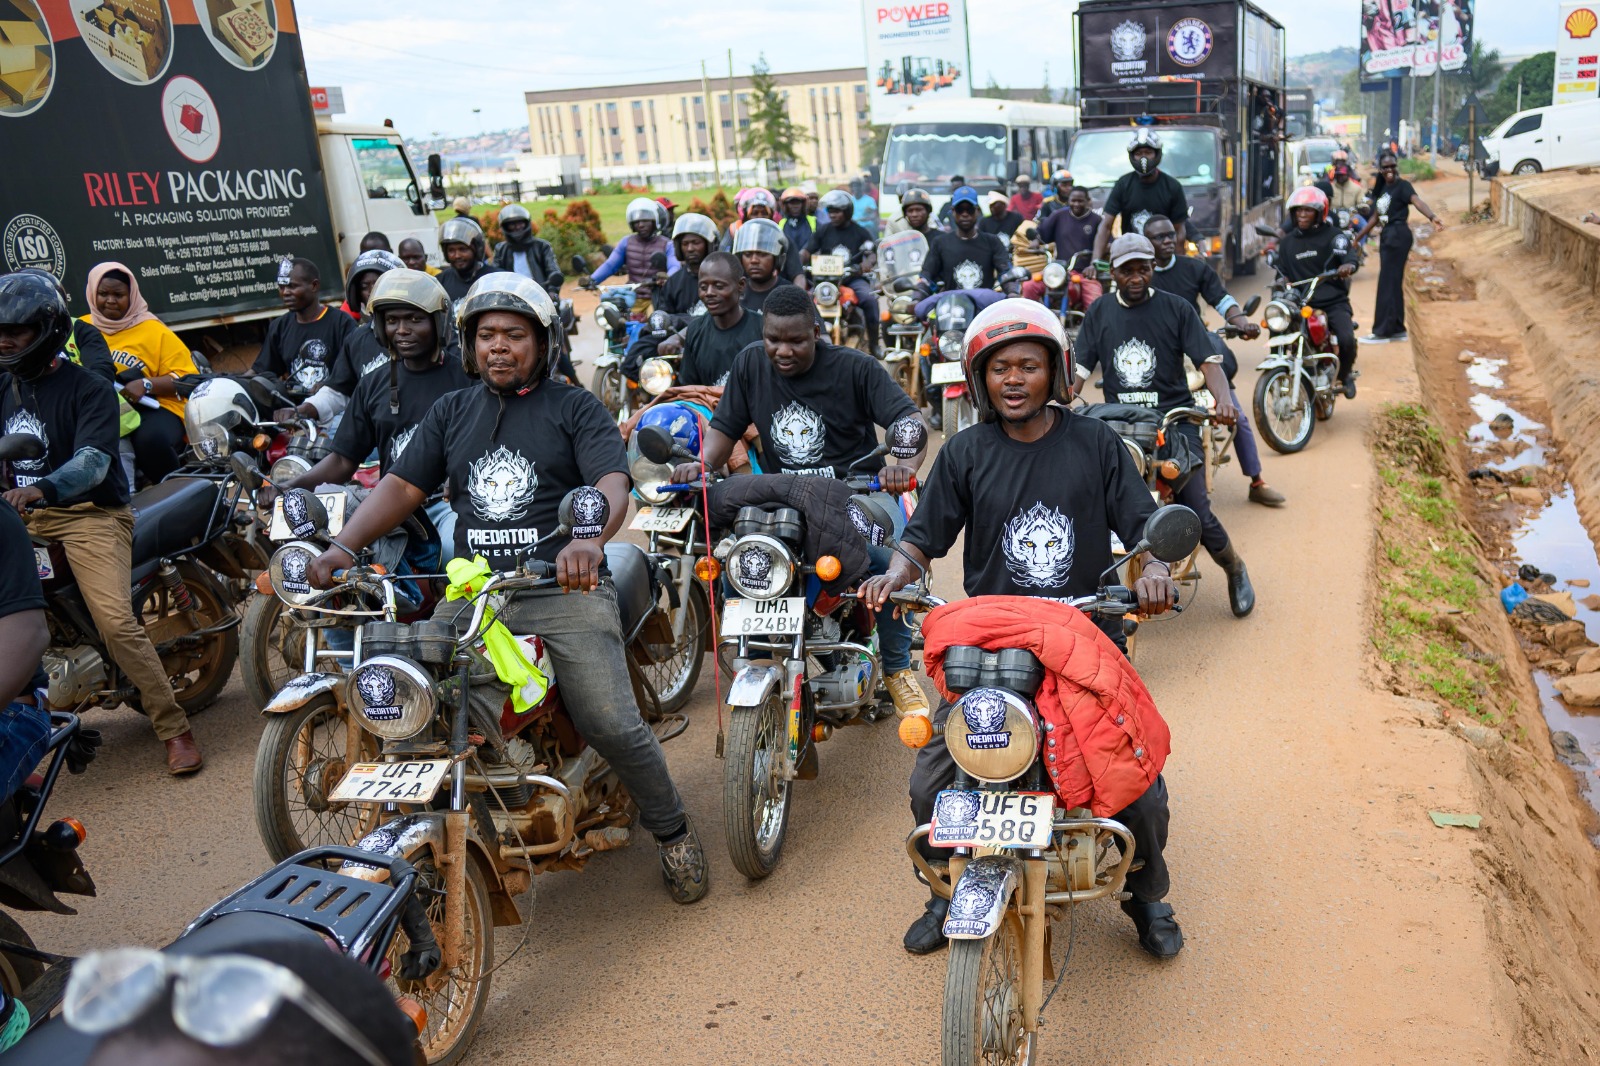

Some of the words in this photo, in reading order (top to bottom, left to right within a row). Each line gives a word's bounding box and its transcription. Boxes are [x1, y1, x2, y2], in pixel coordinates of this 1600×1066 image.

[877, 2, 949, 23] POWER
[84, 171, 160, 207] RILEY
[167, 168, 306, 204] PACKAGING
[134, 210, 193, 226] PACKAGING
[196, 207, 243, 222] SOLUTION
[16, 217, 52, 235] CERTIFIED
[17, 235, 49, 260] ISO
[93, 239, 126, 251] FACTORY:
[126, 237, 144, 248] Block
[240, 229, 251, 240] Box
[50, 235, 63, 277] COMPANY
[164, 249, 176, 260] Tel:
[177, 248, 191, 259] +256
[191, 247, 202, 258] 752
[140, 266, 160, 277] Sales
[160, 264, 182, 275] Office:
[185, 262, 196, 272] 4th
[196, 261, 211, 271] Floor
[212, 259, 233, 270] Acacia
[193, 274, 206, 285] Tel:
[169, 290, 189, 303] Email:
[1117, 391, 1158, 404] PREDATOR
[890, 446, 917, 455] PREDATOR
[656, 507, 687, 519] UFX
[467, 528, 539, 547] PREDATOR
[571, 525, 603, 537] PREDATOR
[283, 580, 309, 590] PREDATOR
[741, 577, 768, 588] PREDATOR
[755, 599, 788, 614] UMA
[741, 616, 800, 632] 824BW
[363, 706, 400, 717] PREDATOR
[967, 732, 1009, 747] PREDATOR
[382, 762, 435, 779] UFP
[356, 780, 422, 798] 774A
[982, 794, 1038, 817] UFG
[935, 827, 976, 838] PREDATOR
[945, 920, 986, 934] PREDATOR
